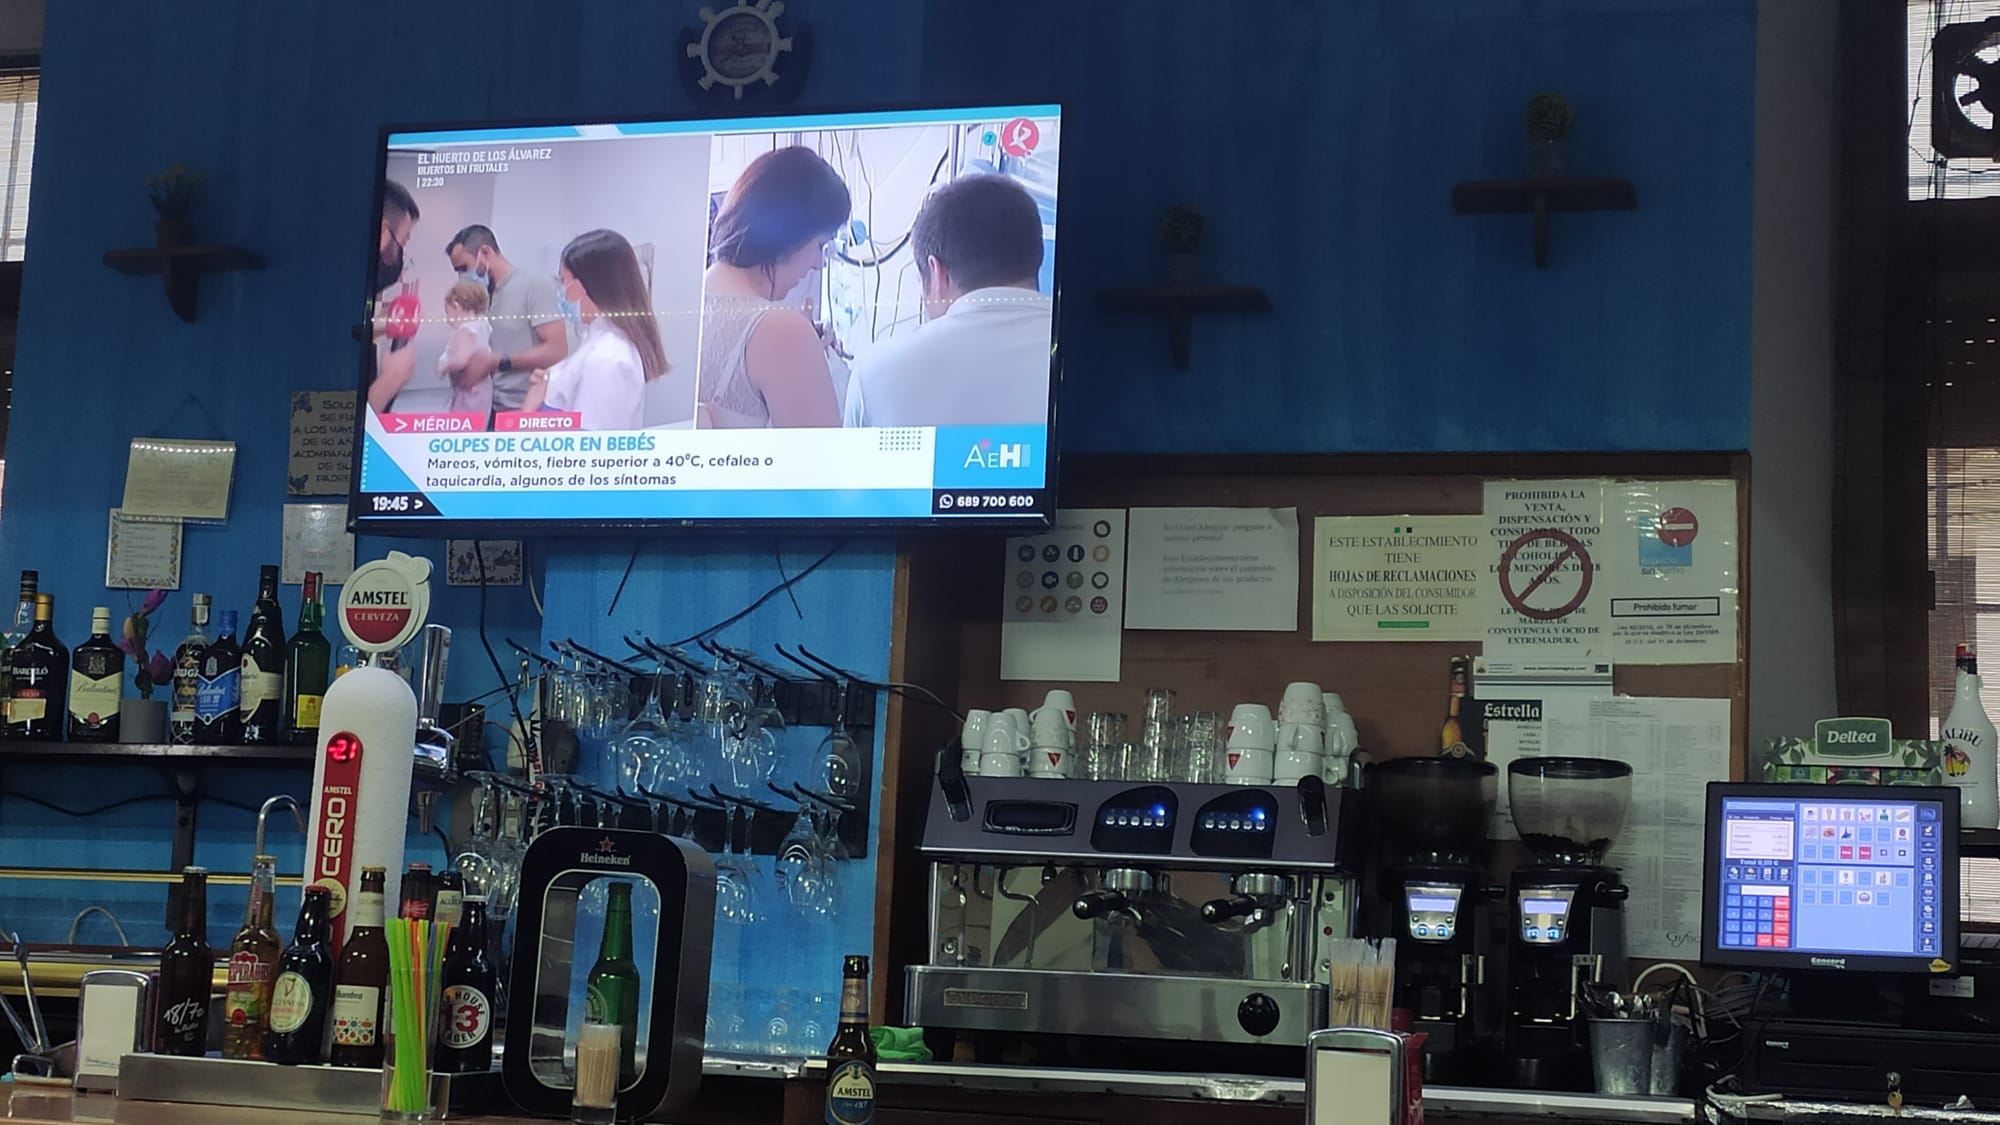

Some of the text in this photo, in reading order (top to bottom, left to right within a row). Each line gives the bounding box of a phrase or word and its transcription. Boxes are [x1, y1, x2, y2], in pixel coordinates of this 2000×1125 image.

[418, 147, 553, 165] EL HUERTO DE LOS ÁLVAREZ
[456, 165, 468, 174] EN
[468, 163, 510, 173] FRUTALES
[322, 400, 355, 410] SOLO
[413, 416, 472, 431] MÉRIDA
[519, 416, 573, 428] DIRECTO
[294, 425, 302, 434] A
[304, 425, 328, 434] LOS
[303, 437, 319, 446] DE
[428, 434, 656, 453] GOLPES DE CALOR EN BEBÉS
[318, 462, 334, 471] DE
[427, 457, 479, 470] Mareos,
[483, 456, 542, 470] vómitos,
[547, 456, 587, 468] fiebre
[591, 455, 648, 470] superior
[652, 459, 661, 467] a
[708, 455, 760, 467] cefalea
[764, 457, 774, 466] o
[426, 473, 677, 488] taquicardia, algunos de los síntomas
[957, 495, 1035, 507] 689 700 600
[1505, 490, 1585, 501] PROHIBIDA LA
[372, 495, 409, 512] 19:45
[1524, 503, 1566, 512] VENTA,
[1499, 513, 1592, 525] DISPENSACIÓN Y
[1569, 526, 1600, 535] TODO
[1329, 535, 1478, 548] ESTE ESTABLECIMIENTO
[1527, 539, 1541, 548] DE
[1384, 552, 1421, 564] TIENE
[1328, 569, 1477, 583] HOJAS DE RECLAMACIONES
[351, 590, 408, 606] AMSTEL
[1329, 586, 1477, 599] A DISPOSICIÓN DEL CONSUMIDOR
[1346, 604, 1458, 616] QUE LAS SOLICITE
[1633, 601, 1697, 612] Prohibido fumar
[353, 612, 400, 622] CERVEZA
[1487, 627, 1550, 635] CONVIVENCIA
[1587, 626, 1600, 634] DE
[1507, 636, 1579, 645] EXTREMADURA.
[1483, 702, 1541, 719] Estrella
[1827, 730, 1878, 744] Deltea
[323, 785, 353, 796] AMSTEL
[321, 797, 349, 877] CERO
[579, 851, 632, 866] Heineken
[455, 989, 486, 1017] HOUSE
[163, 997, 206, 1025] 18/70
[837, 1086, 872, 1098] AMSTEL
